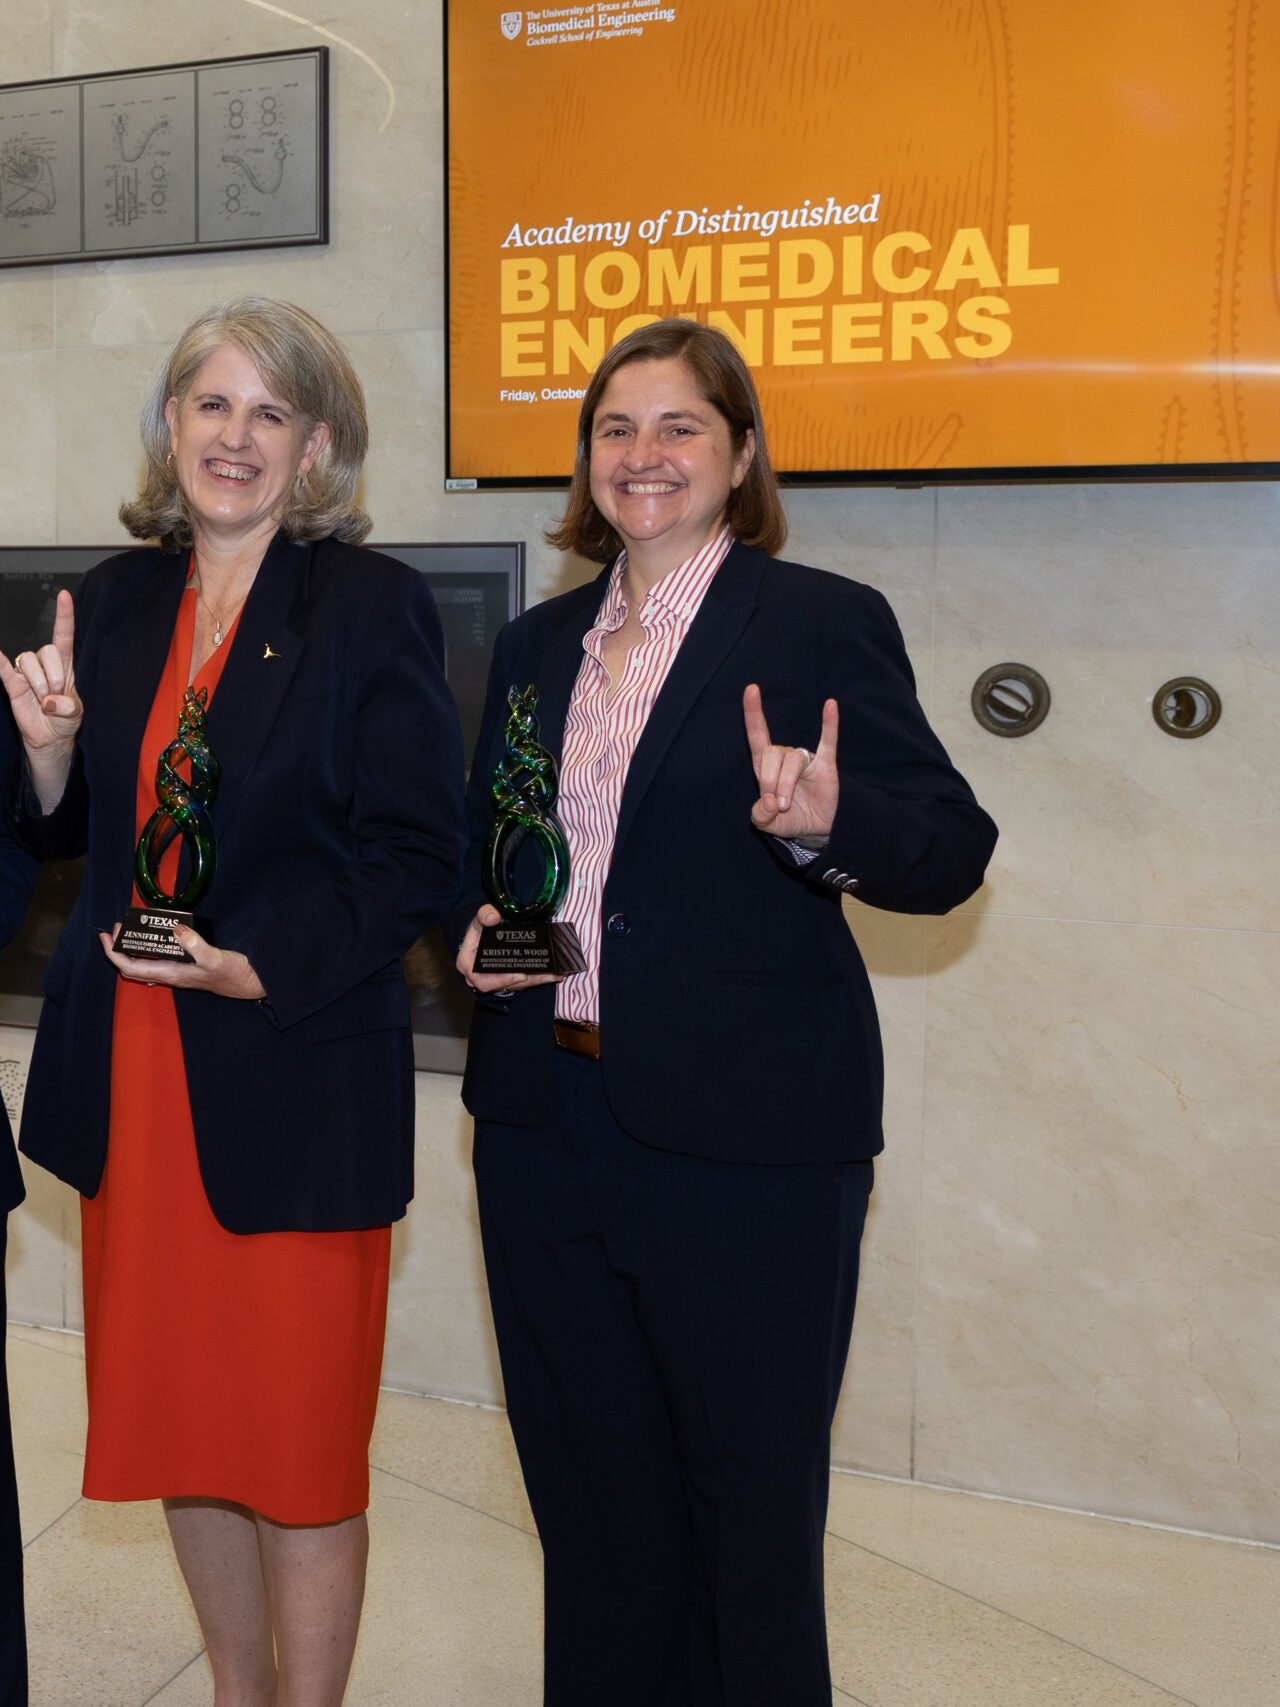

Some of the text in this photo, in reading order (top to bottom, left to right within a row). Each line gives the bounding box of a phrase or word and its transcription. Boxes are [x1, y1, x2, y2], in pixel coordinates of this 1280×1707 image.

[527, 11, 541, 20] The
[542, 7, 584, 19] University
[585, 4, 595, 13] of
[597, 2, 620, 12] Texas
[622, 1, 630, 9] at
[527, 8, 676, 35] Biomedical Engineering
[526, 26, 644, 46] Cockrell School of Engineering
[501, 194, 881, 248] Academy of Distinguished
[500, 224, 1060, 314] BIOMEDICAL
[500, 295, 1013, 377] ENNEERS
[500, 389, 538, 403] Friday,
[148, 916, 179, 927] TEXAS
[121, 939, 157, 948] DISTINGUISHED
[124, 931, 159, 941] JENNIFER
[505, 931, 536, 940] TEXAS
[152, 947, 184, 956] ENGINEERING
